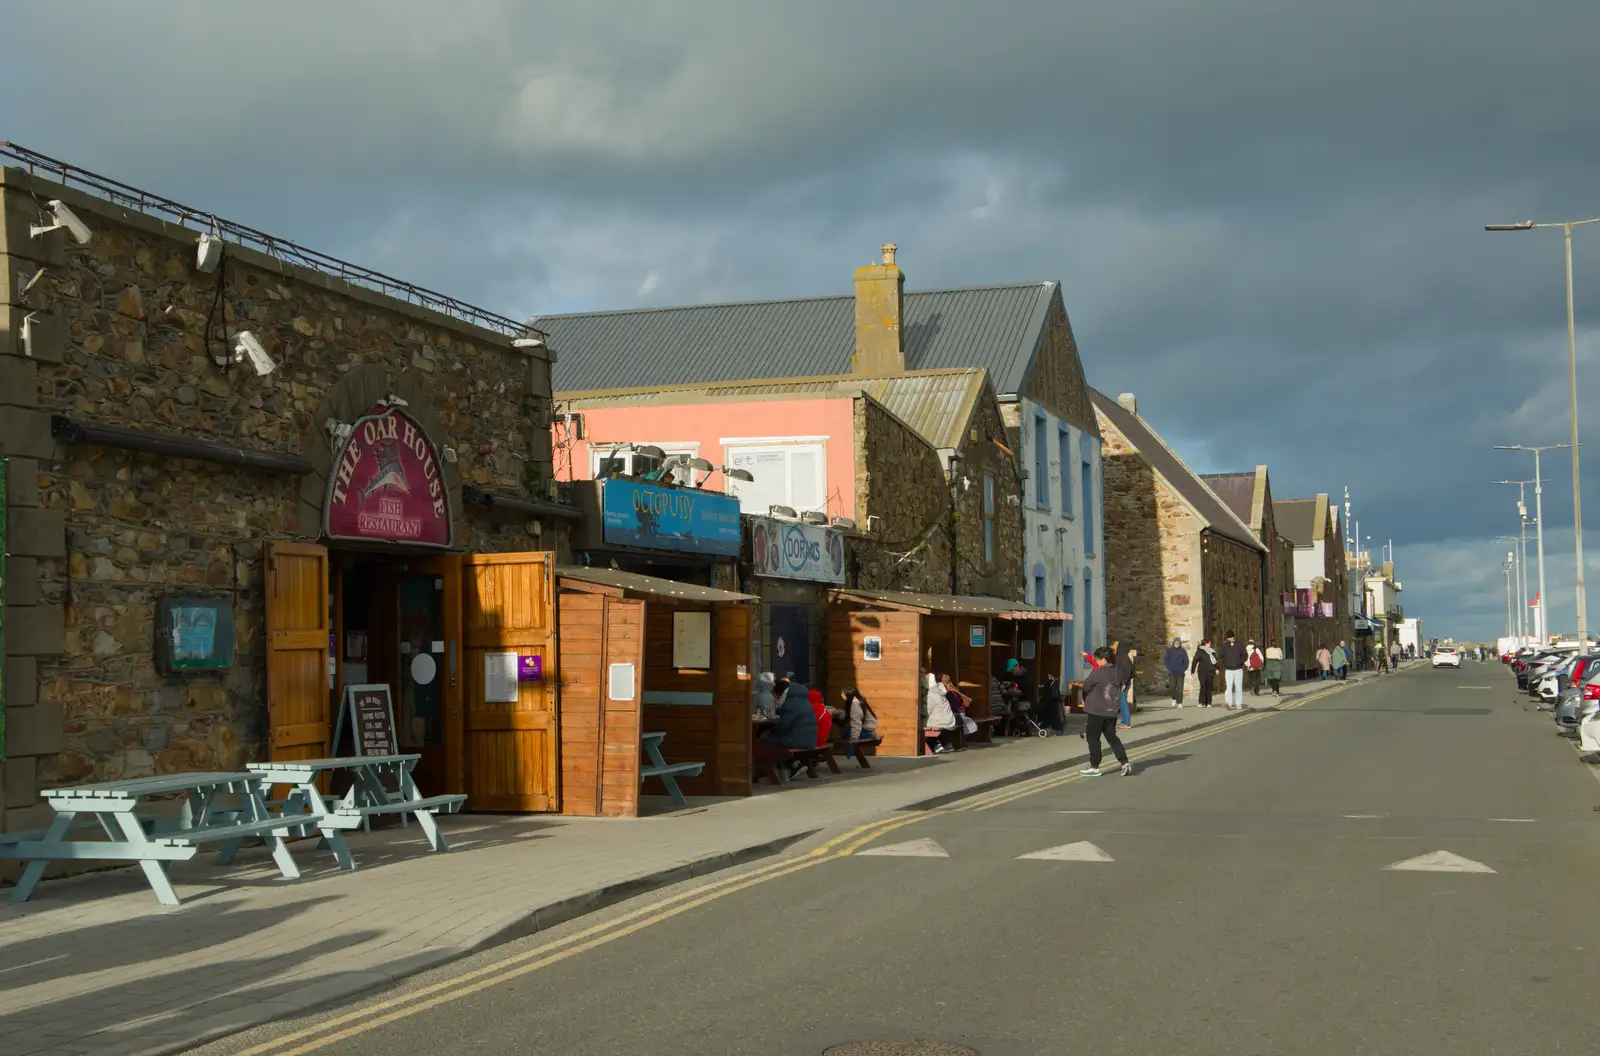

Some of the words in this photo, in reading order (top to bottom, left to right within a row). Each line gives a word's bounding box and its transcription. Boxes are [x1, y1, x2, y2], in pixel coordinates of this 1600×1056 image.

[333, 439, 361, 505] THE
[364, 416, 398, 446] OAR
[402, 420, 445, 519] HOUSE
[380, 499, 402, 516] FISH
[632, 489, 695, 522] OCTOPUSSY
[360, 517, 421, 535] RESTAURANT
